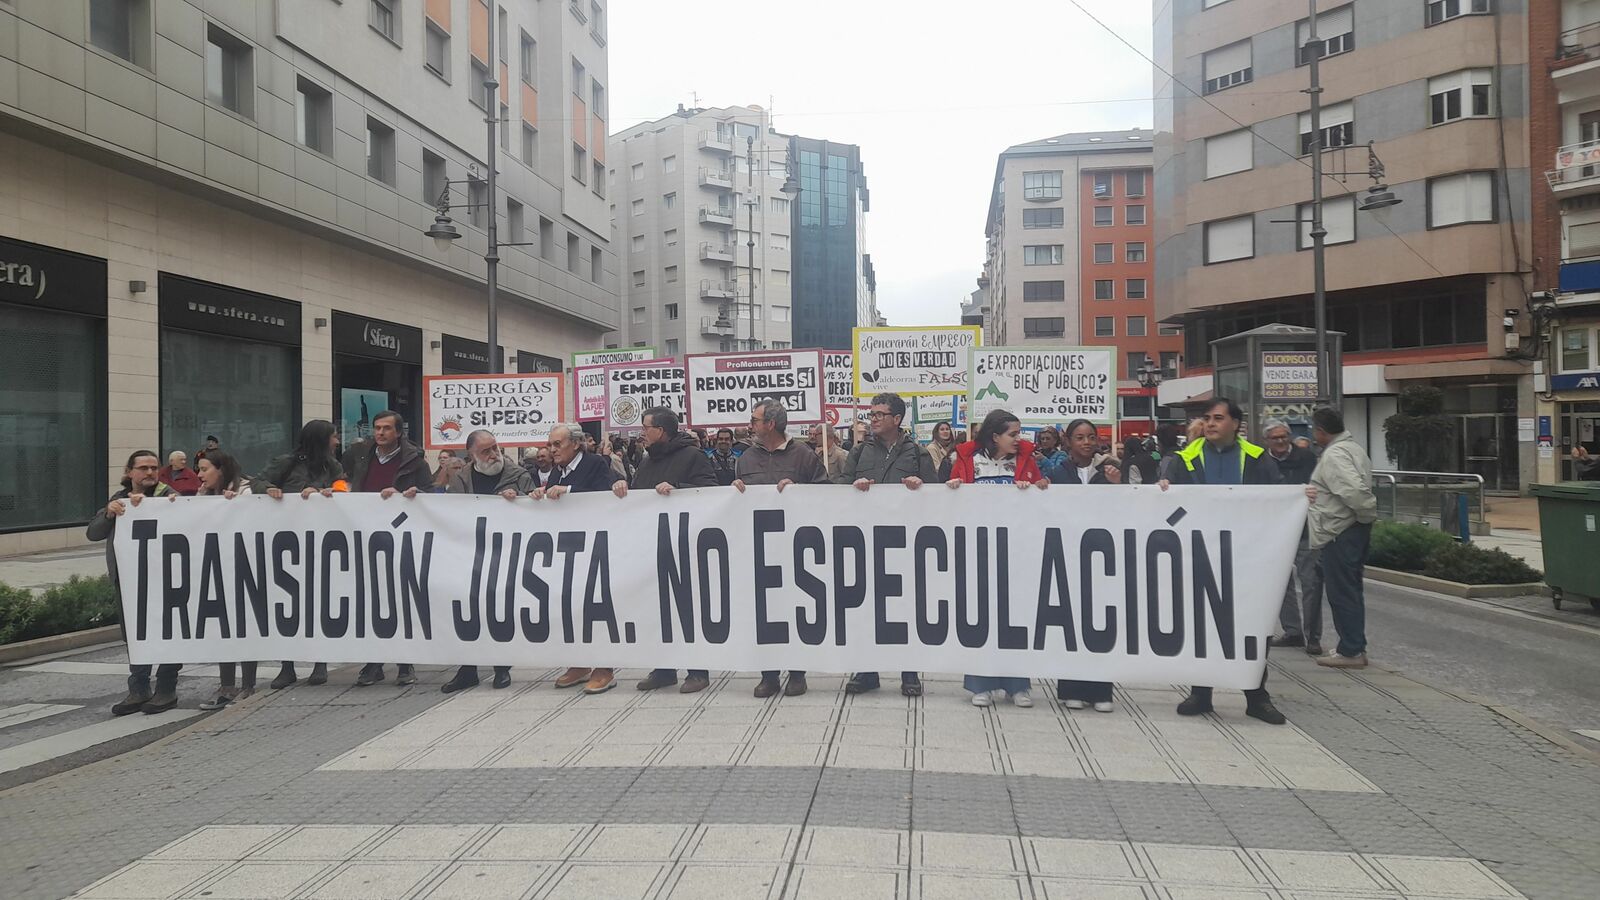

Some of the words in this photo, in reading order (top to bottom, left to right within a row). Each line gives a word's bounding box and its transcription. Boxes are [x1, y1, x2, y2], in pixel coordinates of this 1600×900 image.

[188, 301, 285, 326] www.sfera.com
[591, 352, 633, 364] AUTOCONSUMO
[726, 359, 789, 369] ProMonumenta
[822, 354, 853, 368] ARC
[879, 353, 893, 368] NO
[897, 353, 911, 367] ES
[913, 352, 956, 367] VERDAD
[977, 354, 1084, 374] ¿EXPROPIACIONES
[696, 373, 795, 391] RENOVABLES
[798, 367, 813, 388] SÍ
[1014, 371, 1039, 393] BIEN
[1265, 370, 1290, 380] VENDE
[1576, 377, 1599, 388] AXA
[433, 380, 552, 398] ¿ENERGÍAS
[443, 395, 543, 409] LIMPIAS?
[707, 397, 747, 413] PERO
[1076, 394, 1105, 404] BIEN
[1058, 404, 1105, 416] QUIEN?
[132, 512, 433, 640] TRANSICIÓN
[452, 516, 636, 643] JUSTA.
[656, 512, 731, 644] NO
[753, 506, 1258, 660] ESPECULACIÓN.
